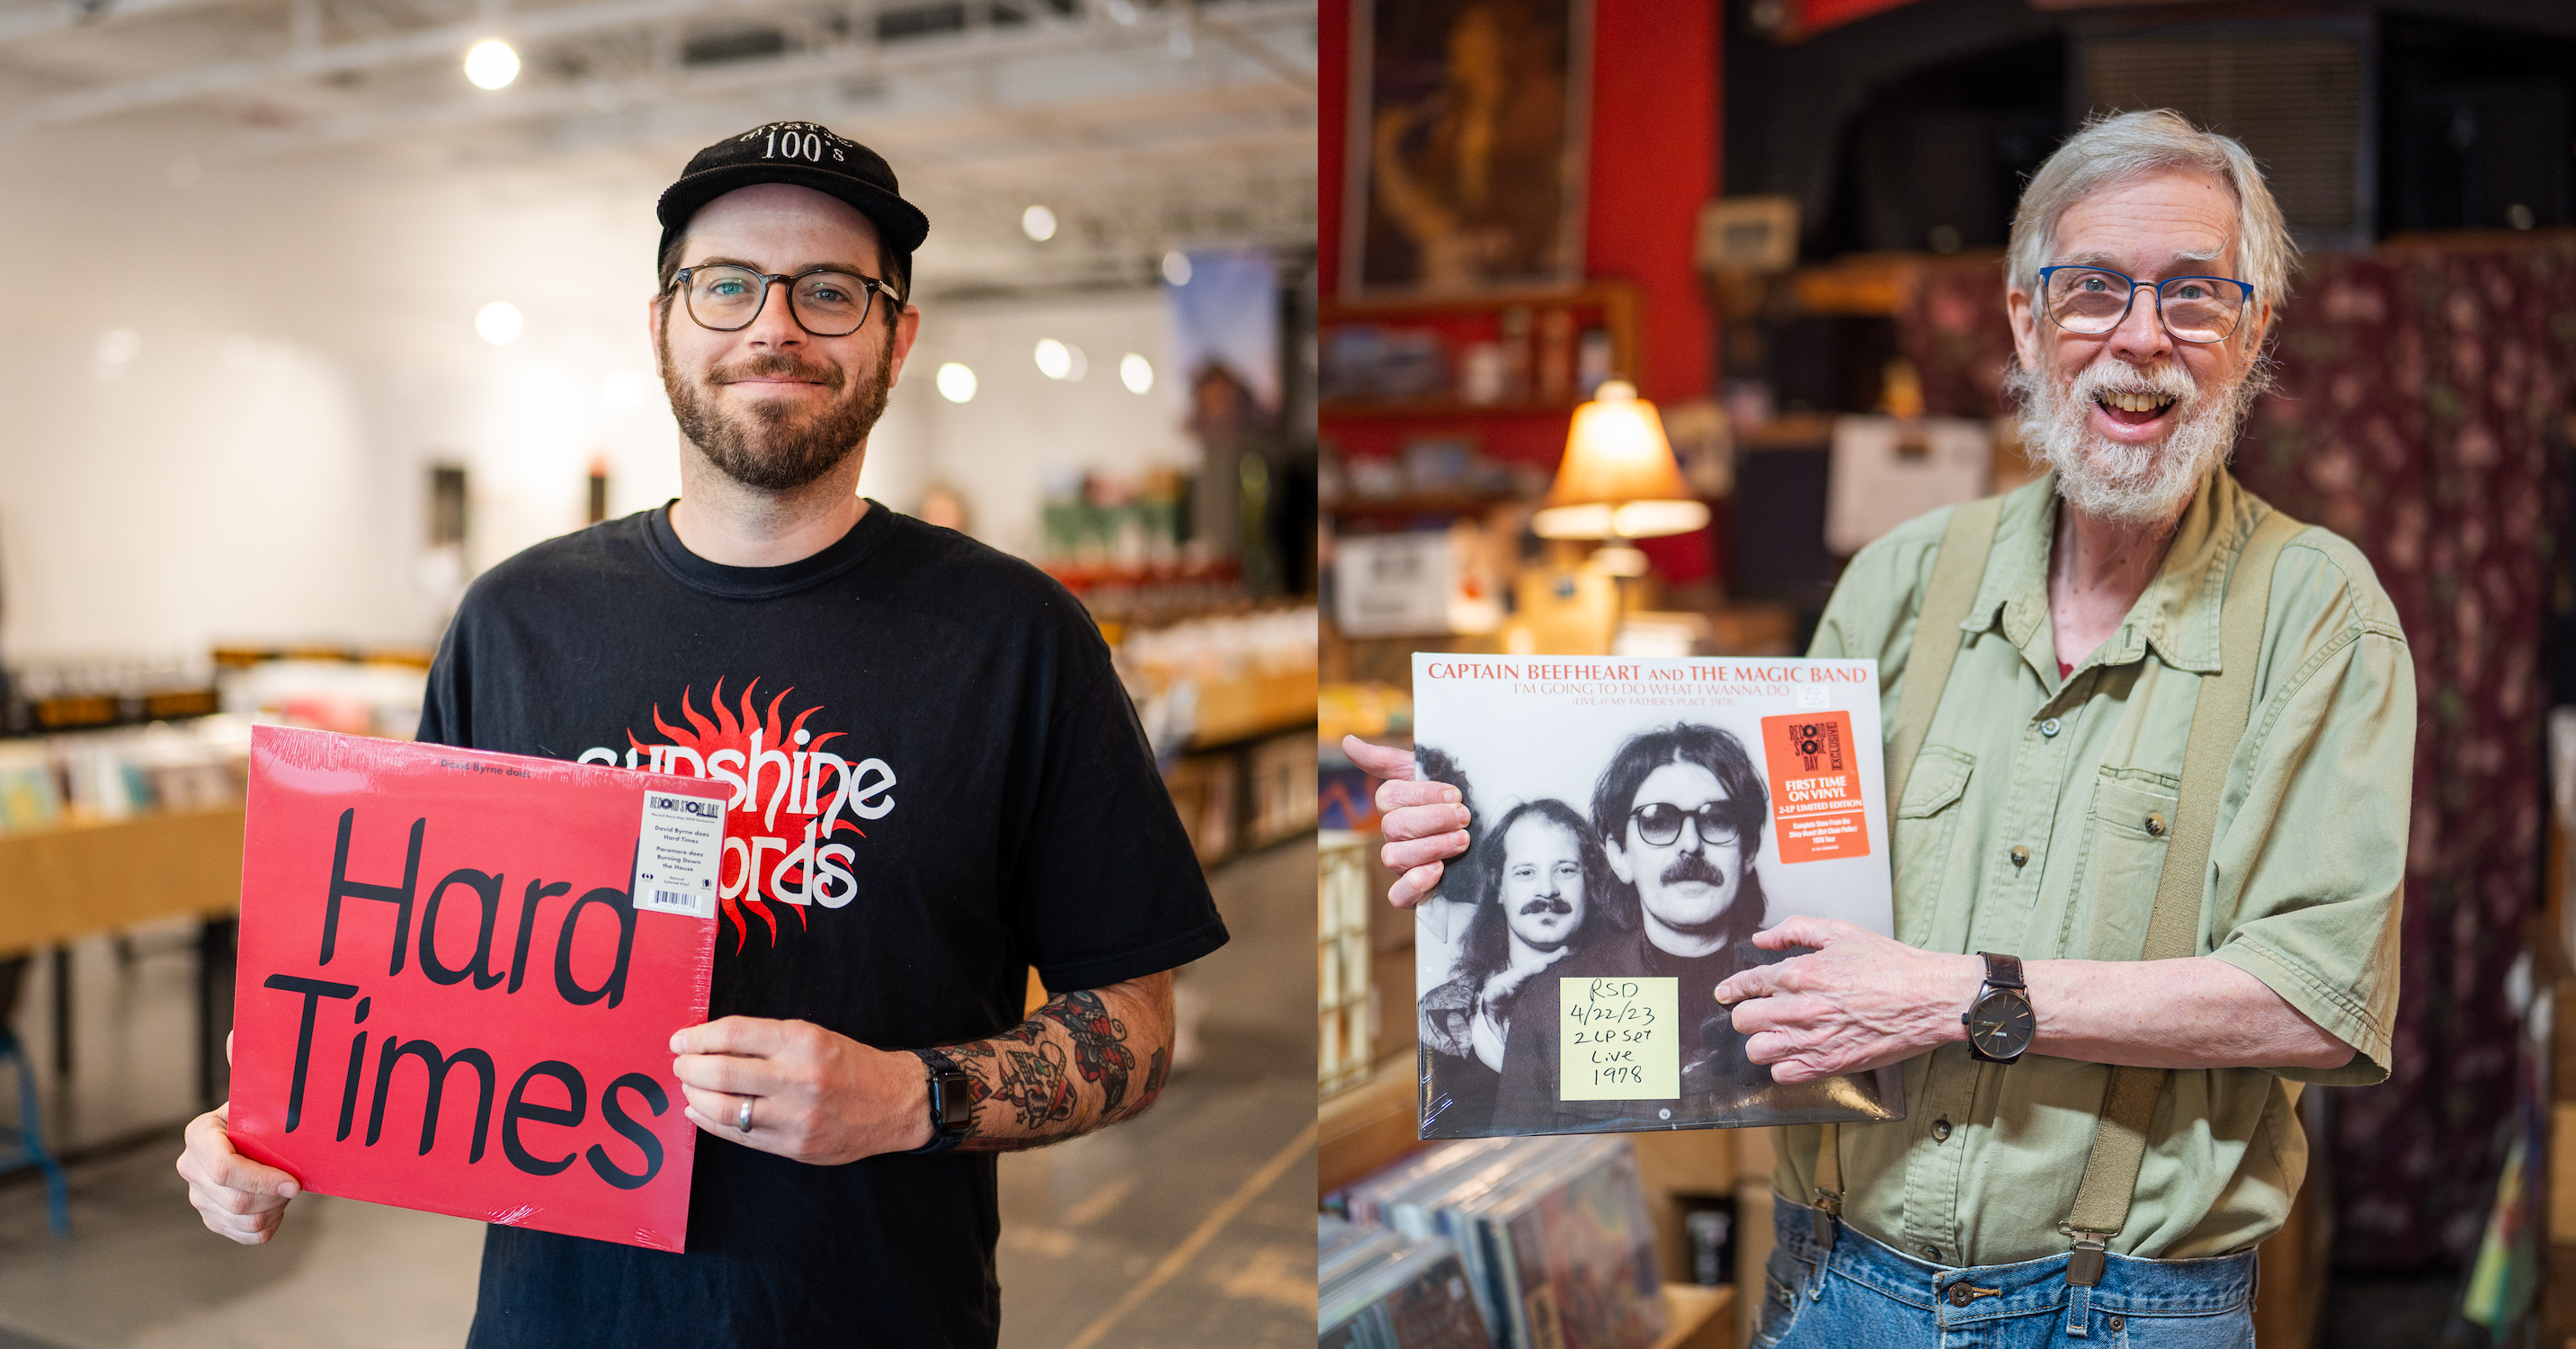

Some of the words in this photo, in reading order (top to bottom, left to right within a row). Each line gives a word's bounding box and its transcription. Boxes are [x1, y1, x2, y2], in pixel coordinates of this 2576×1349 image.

[761, 130, 844, 162] 100's
[1428, 663, 1520, 680] CAPTAIN
[1528, 664, 1641, 681] BEEFHEART
[1648, 669, 1683, 681] AND
[1689, 666, 1728, 682] THE
[1734, 666, 1804, 683] MAGIC
[1810, 667, 1867, 683] BAND
[1514, 683, 1536, 694] I'M
[1541, 683, 1593, 695] GOING
[1597, 683, 1618, 695] TO
[1622, 683, 1646, 695] DO
[1649, 683, 1693, 695] WHAT
[1706, 684, 1762, 696] WANNA
[1767, 685, 1790, 696] DO
[1573, 697, 1596, 706] (LIVE
[1611, 698, 1627, 706] MY
[1630, 698, 1674, 706] FATHER'S
[1677, 698, 1707, 707] PLACE
[1710, 698, 1735, 707] 1978)
[1789, 723, 1825, 740] RECORD
[1794, 738, 1826, 756] STORE
[1827, 723, 1841, 768] EXCLUSIVE
[441, 759, 470, 771] David
[473, 763, 503, 774] Byrne
[505, 767, 530, 778] does
[1804, 755, 1818, 772] DAY
[1785, 778, 1816, 791] FIRST
[1817, 776, 1847, 789] TIME
[1788, 791, 1809, 802] ON
[1810, 787, 1847, 800] VINYL
[650, 796, 680, 811] RECORD
[680, 800, 706, 814] STORE
[706, 803, 719, 817] DAY
[1778, 805, 1796, 814] 2-LP
[1796, 801, 1828, 812] LIMITED
[1829, 800, 1862, 809] EDITION
[655, 825, 673, 833] David
[674, 827, 693, 835] Byrne
[656, 845, 687, 855] Paramore
[656, 853, 682, 863] Burning
[318, 808, 641, 1010] Hard
[1590, 978, 1638, 1002] RSD
[1570, 1000, 1655, 1026] 4/22/23
[1573, 1032, 1592, 1045] 2
[1594, 1030, 1617, 1043] LP
[1591, 1050, 1636, 1064] Live
[263, 973, 670, 1191] Times
[1594, 1065, 1642, 1085] 1978
